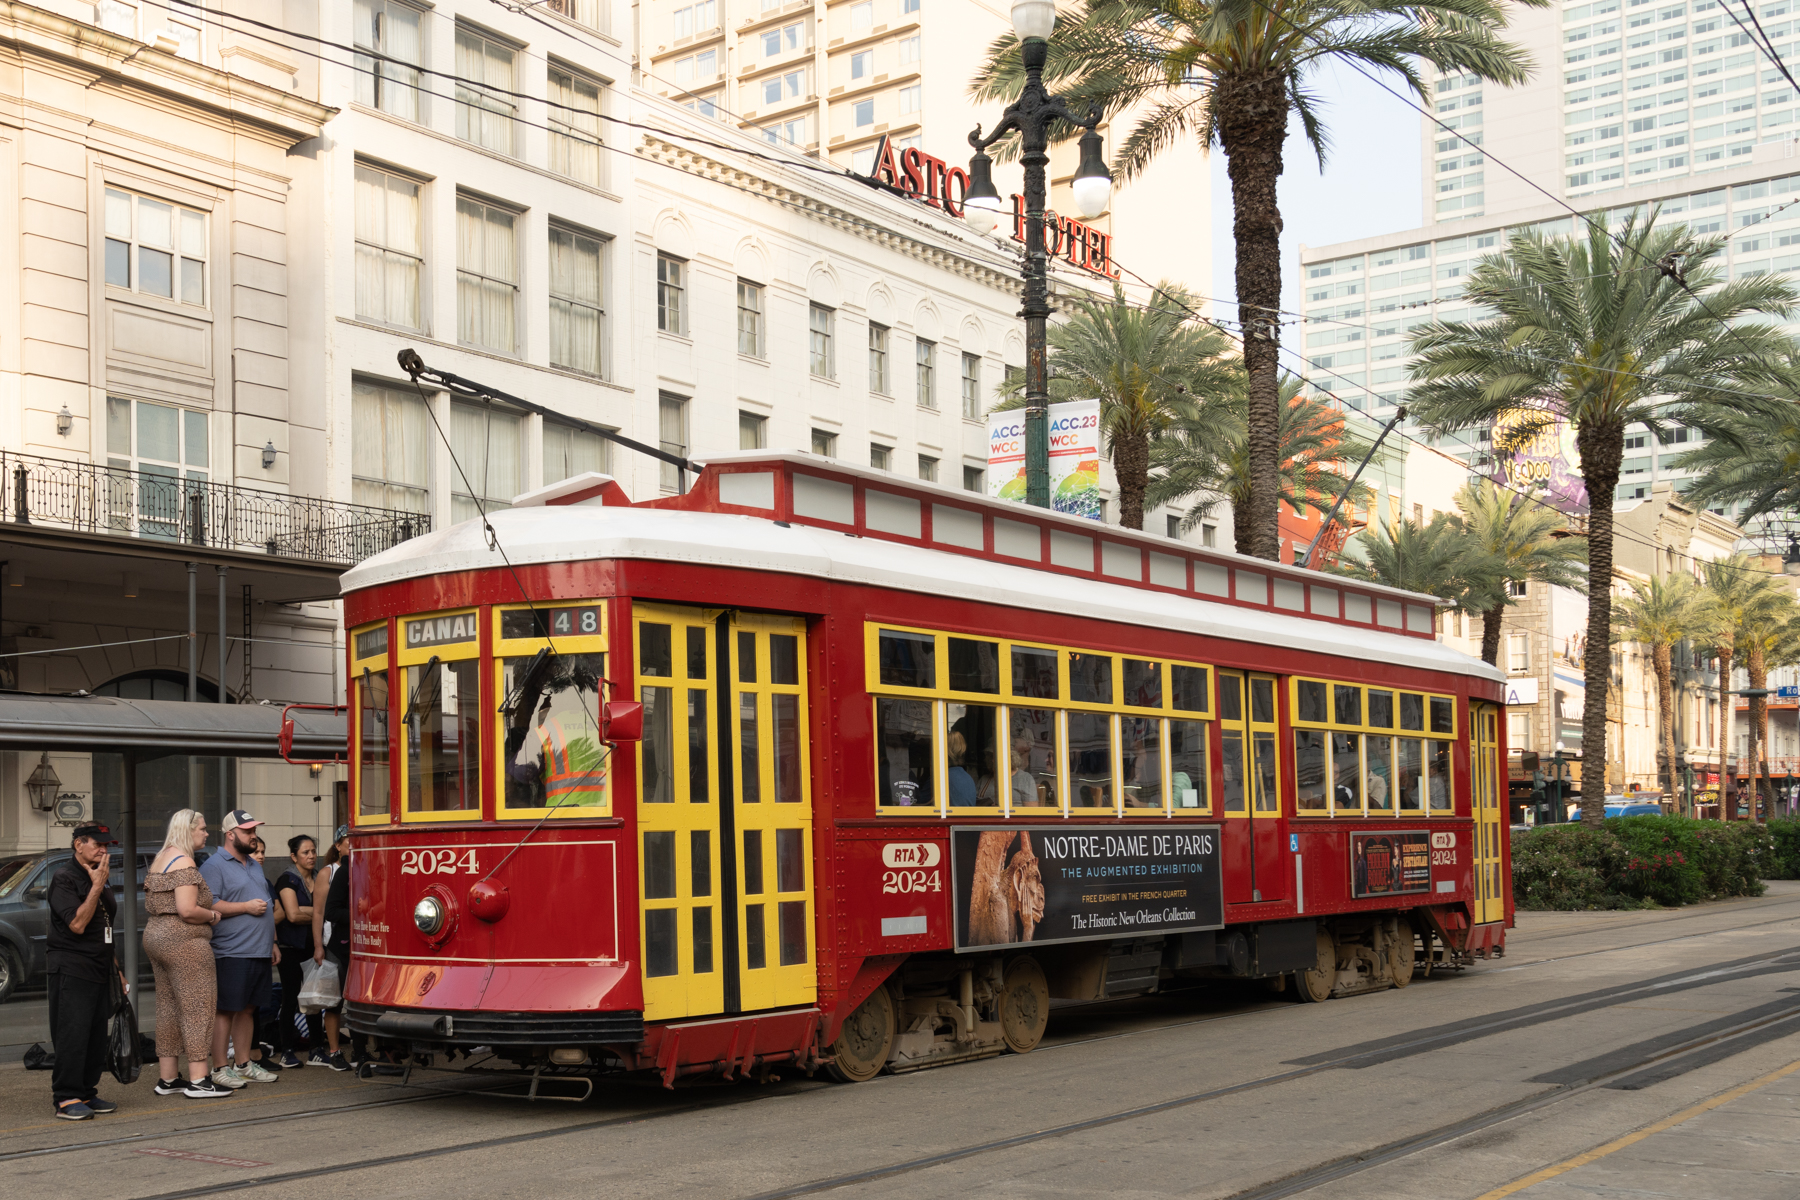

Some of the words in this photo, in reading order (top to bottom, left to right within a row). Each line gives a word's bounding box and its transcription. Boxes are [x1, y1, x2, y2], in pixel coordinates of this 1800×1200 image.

[871, 134, 997, 229] ASTO
[1050, 415, 1097, 432] ACC.23
[991, 441, 1019, 454] WCC
[1050, 434, 1079, 447] WCC
[1504, 459, 1552, 484] VOODOO
[408, 612, 477, 644] CANAL
[1507, 689, 1521, 704] A
[1786, 686, 1798, 695] Ro
[563, 723, 585, 731] RTA
[1044, 835, 1149, 859] NOTRE-DAME
[1152, 835, 1172, 856] DE
[1175, 834, 1213, 855] PARIS
[1436, 836, 1446, 845] RTA
[401, 849, 480, 875] 2024
[894, 848, 915, 863] RTA
[1431, 850, 1457, 866] 2024
[1061, 867, 1082, 878] THE
[1086, 865, 1148, 877] AUGMENTED
[1151, 863, 1203, 875] EXHIBITION
[882, 870, 942, 895] 2024
[1082, 894, 1098, 903] FREE
[1098, 893, 1121, 902] EXHIBIT
[1121, 892, 1128, 900] IN
[1128, 892, 1139, 900] THE
[1140, 890, 1162, 900] FRENCH
[1162, 889, 1187, 898] QUARTER
[1071, 914, 1087, 929] The
[1088, 912, 1118, 928] Historic
[1118, 911, 1135, 925] New
[1135, 909, 1162, 925] Orleans
[1162, 907, 1196, 922] Collection
[368, 921, 379, 932] Exact
[380, 922, 390, 933] Fare
[370, 935, 382, 948] Ready
